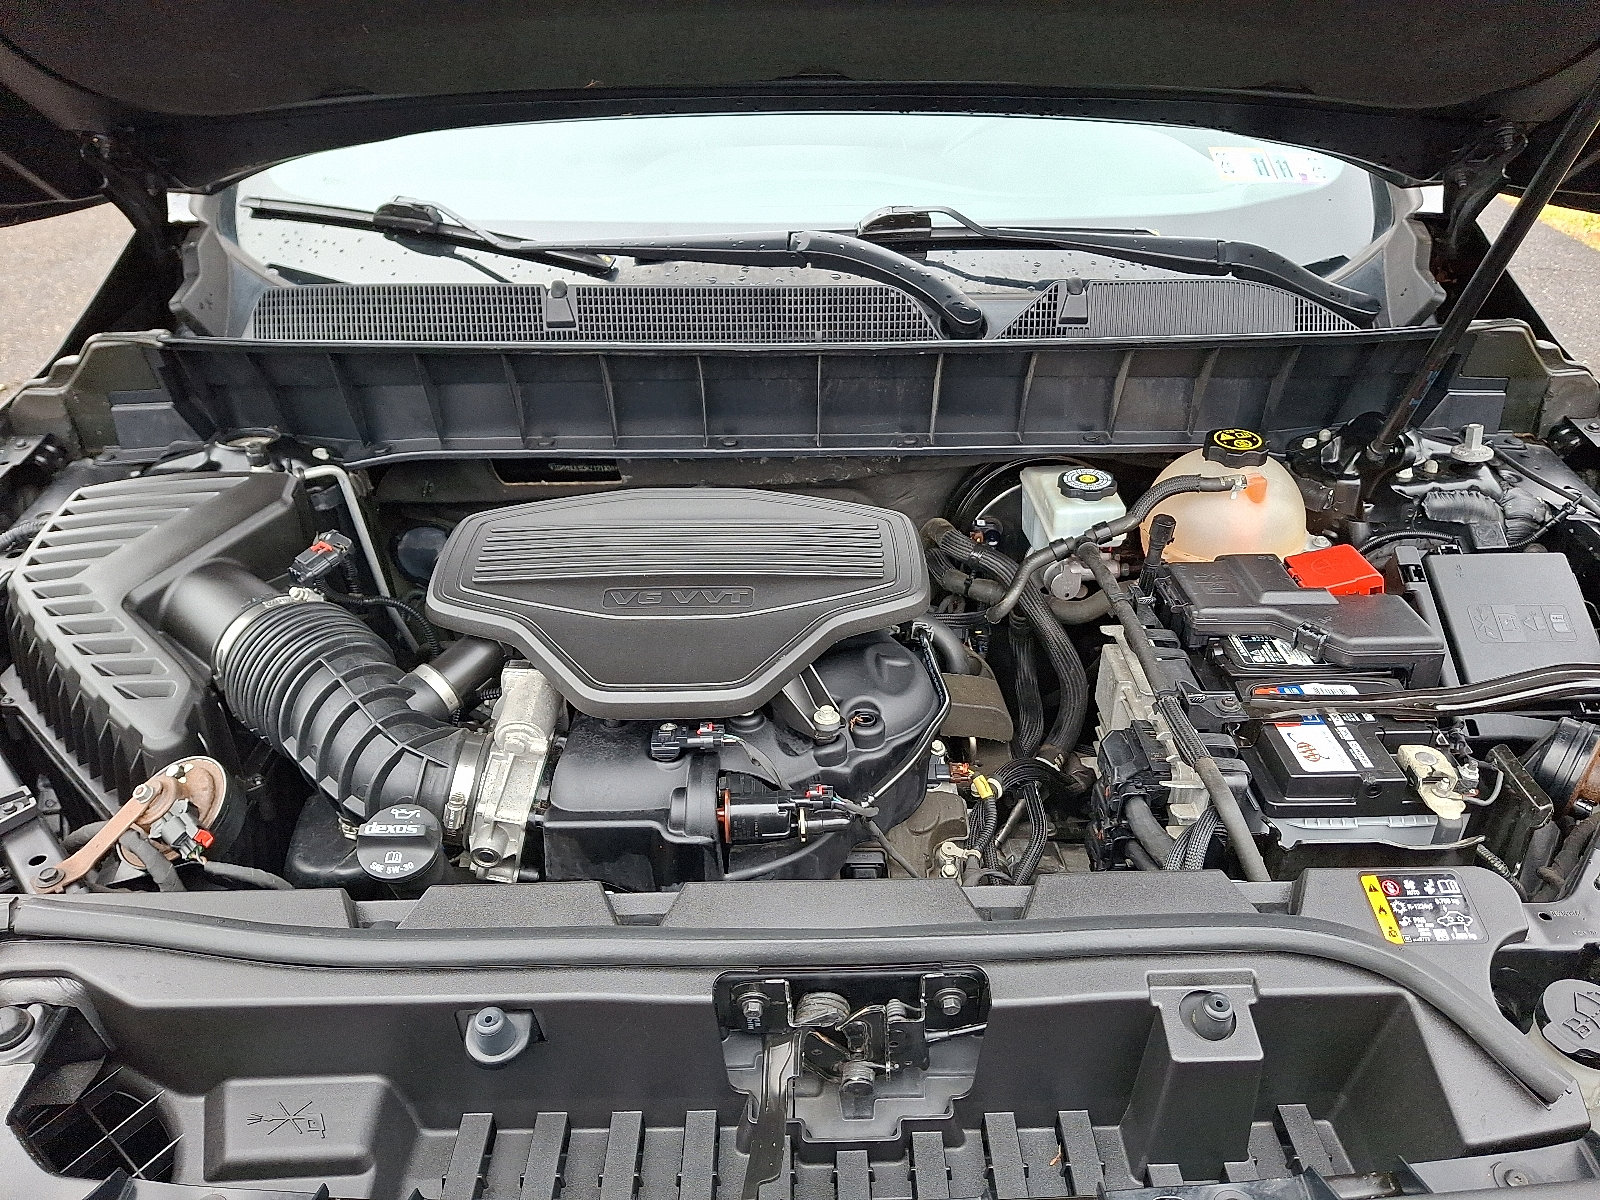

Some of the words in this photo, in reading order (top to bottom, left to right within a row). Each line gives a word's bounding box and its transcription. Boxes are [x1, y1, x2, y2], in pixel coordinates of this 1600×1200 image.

[610, 590, 663, 605] V6
[671, 590, 748, 604] VVT
[364, 821, 418, 834] dexos
[385, 861, 414, 874] 5W-30
